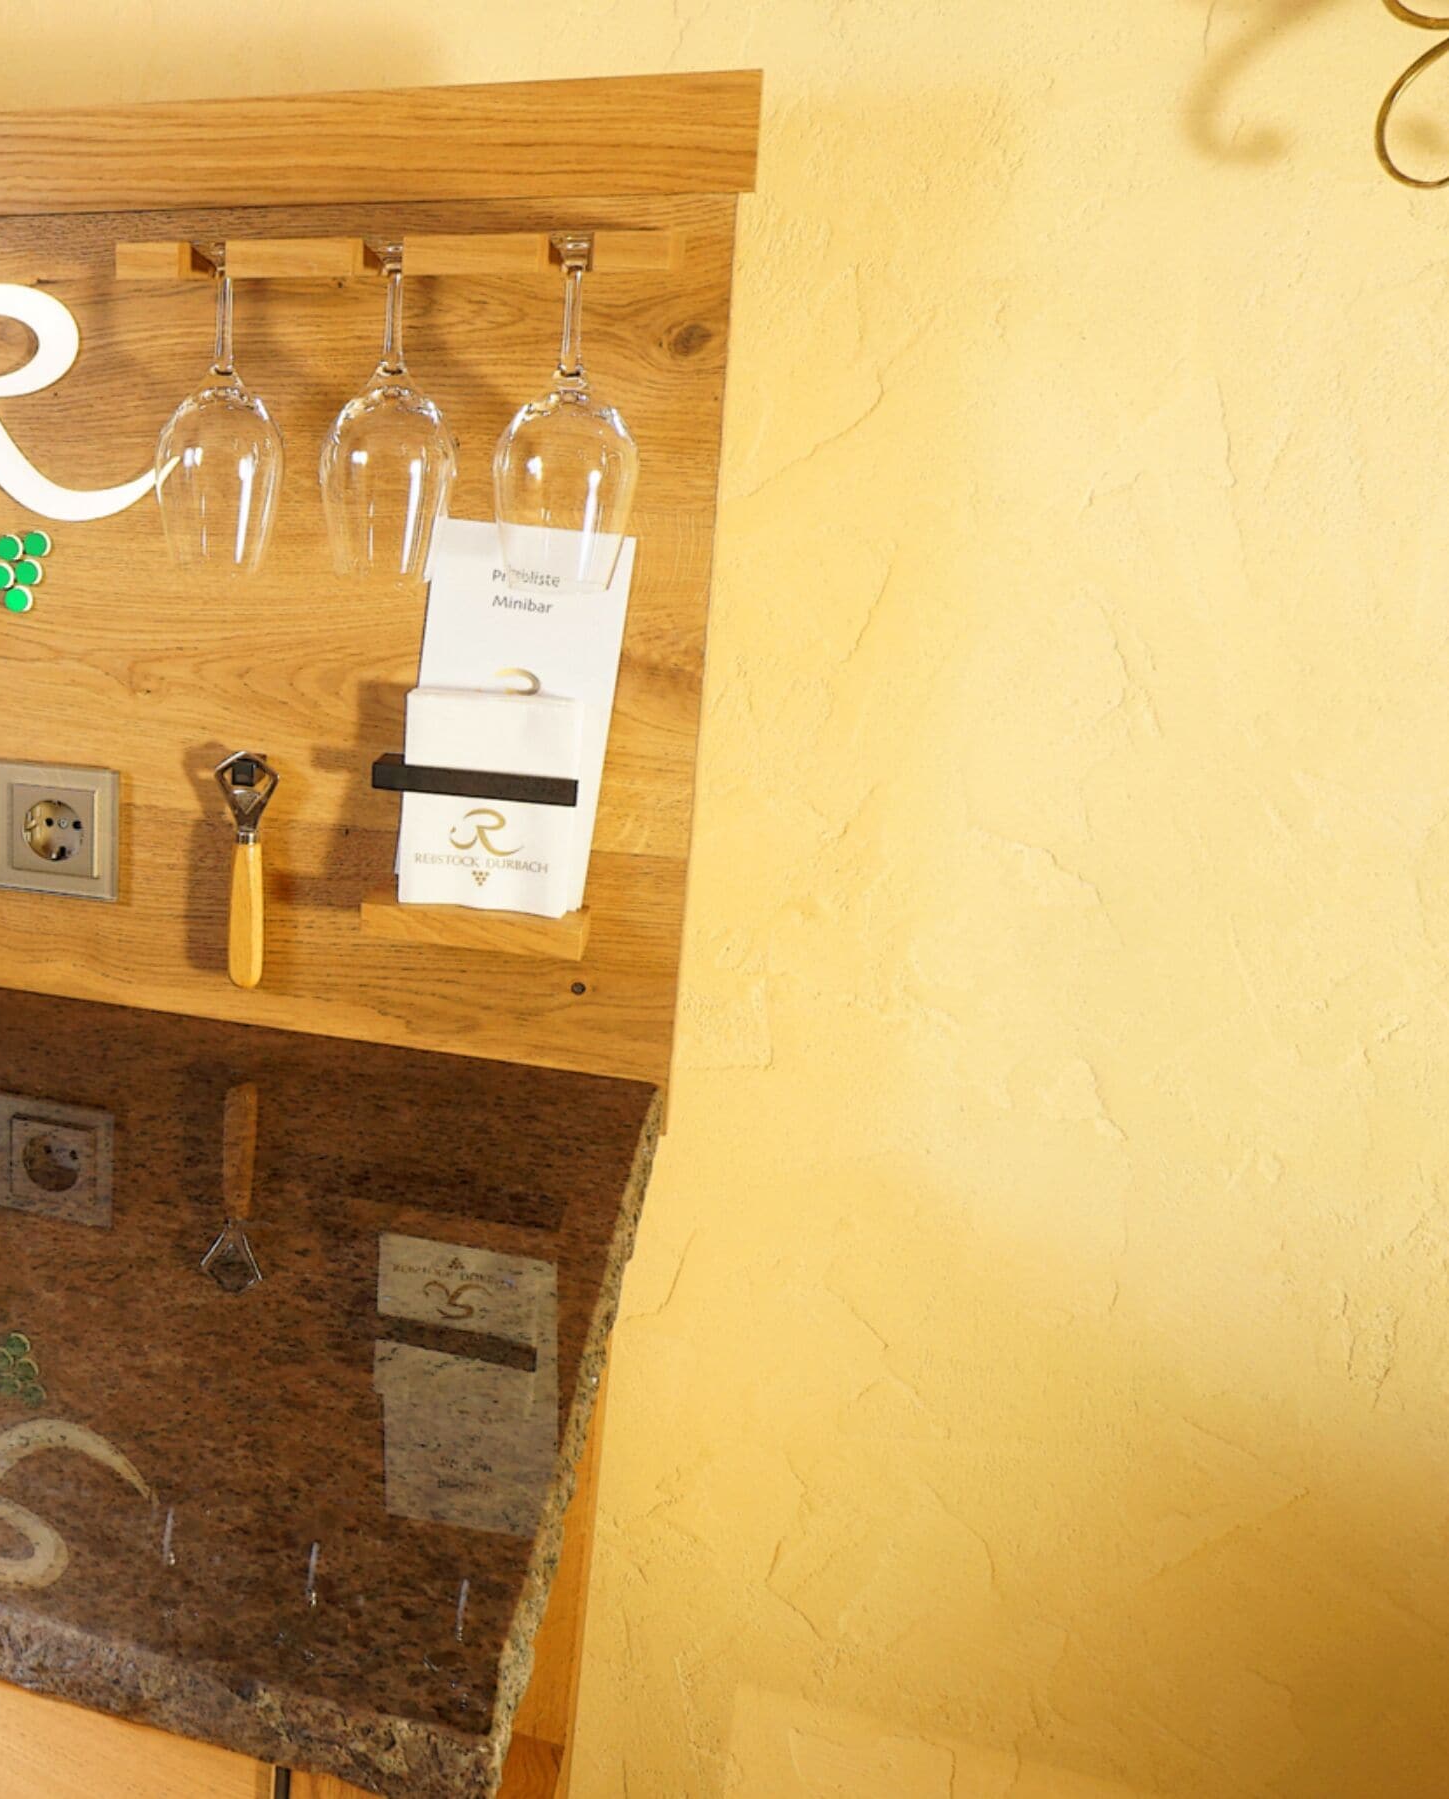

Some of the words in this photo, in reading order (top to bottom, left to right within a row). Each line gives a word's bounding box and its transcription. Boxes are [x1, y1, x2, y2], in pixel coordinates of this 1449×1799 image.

[492, 595, 554, 614] Minibar
[414, 852, 480, 868] REBSTOCK
[485, 857, 549, 874] DURBACH
